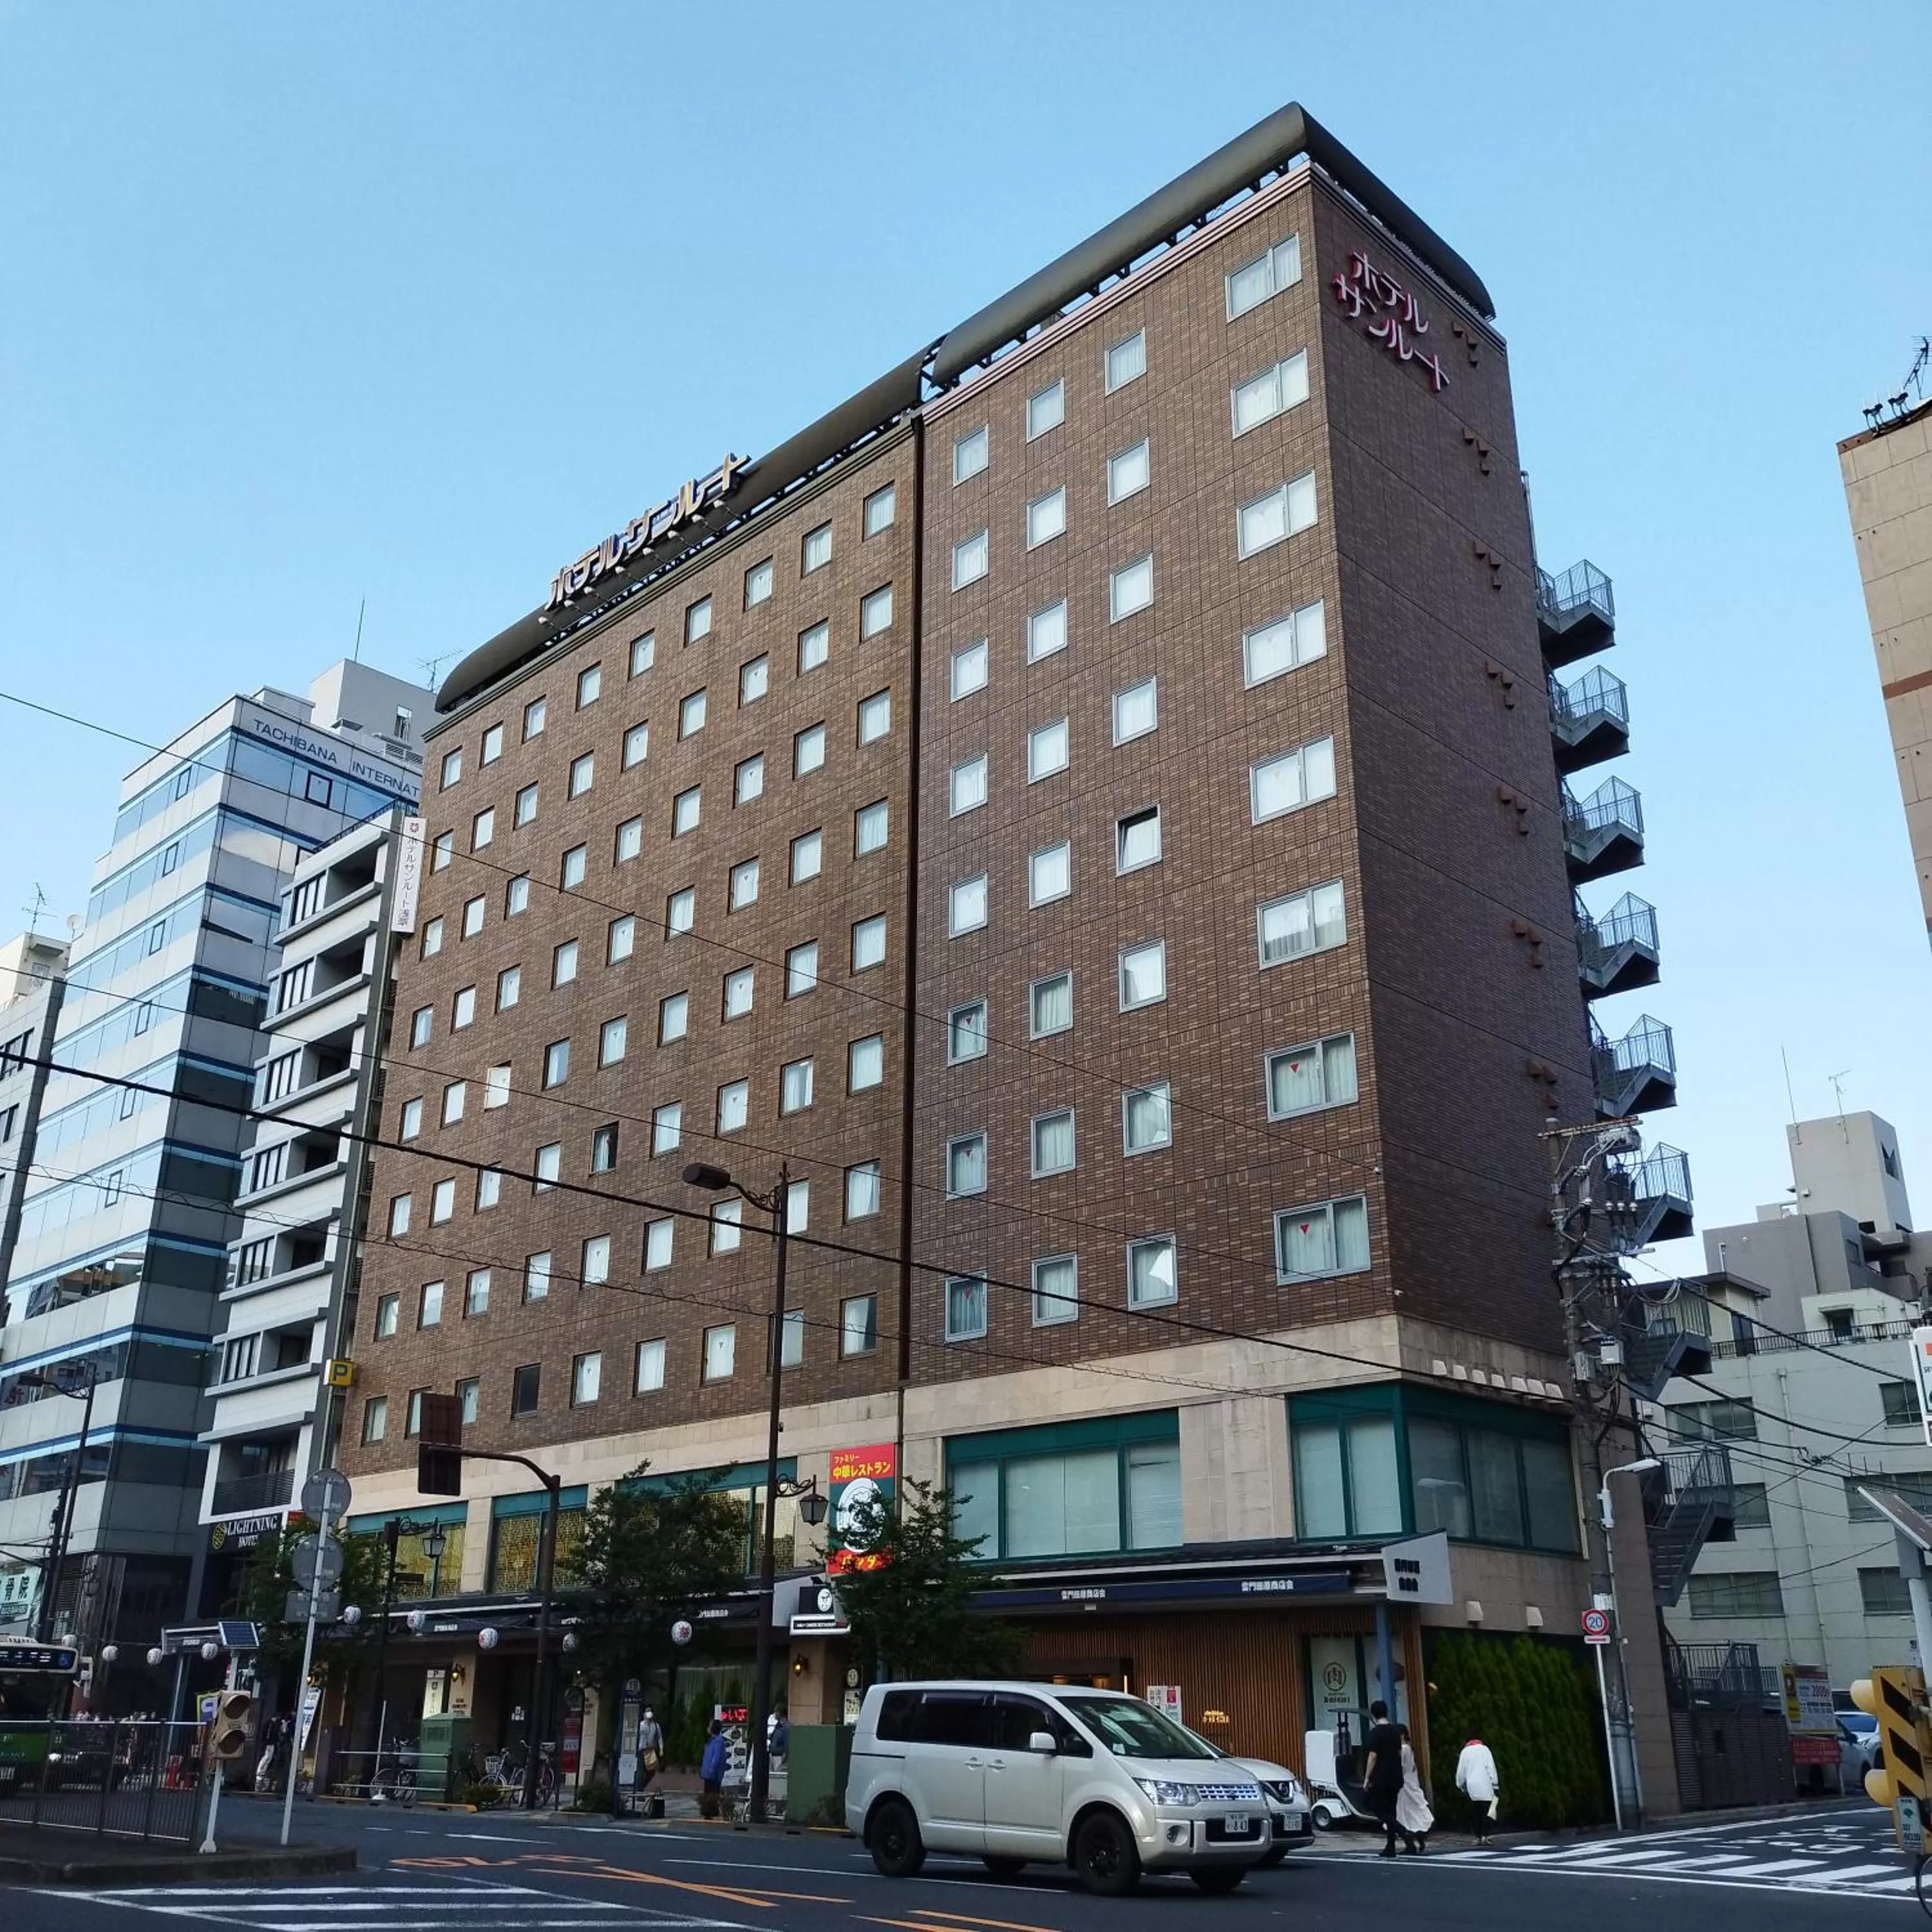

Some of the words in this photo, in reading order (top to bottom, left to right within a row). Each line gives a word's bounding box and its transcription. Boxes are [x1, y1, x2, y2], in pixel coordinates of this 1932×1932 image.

[1351, 251, 1429, 334] ホテル
[1333, 274, 1450, 392] サンルート
[544, 452, 752, 611] ホテルサンルート
[254, 719, 337, 764] TACHIBANA
[332, 1363, 348, 1381] P
[834, 1454, 860, 1464] ファミリー
[833, 1461, 891, 1479] 中華レストラン
[227, 1515, 278, 1536] LIGHTNING
[1588, 1615, 1603, 1629] 20
